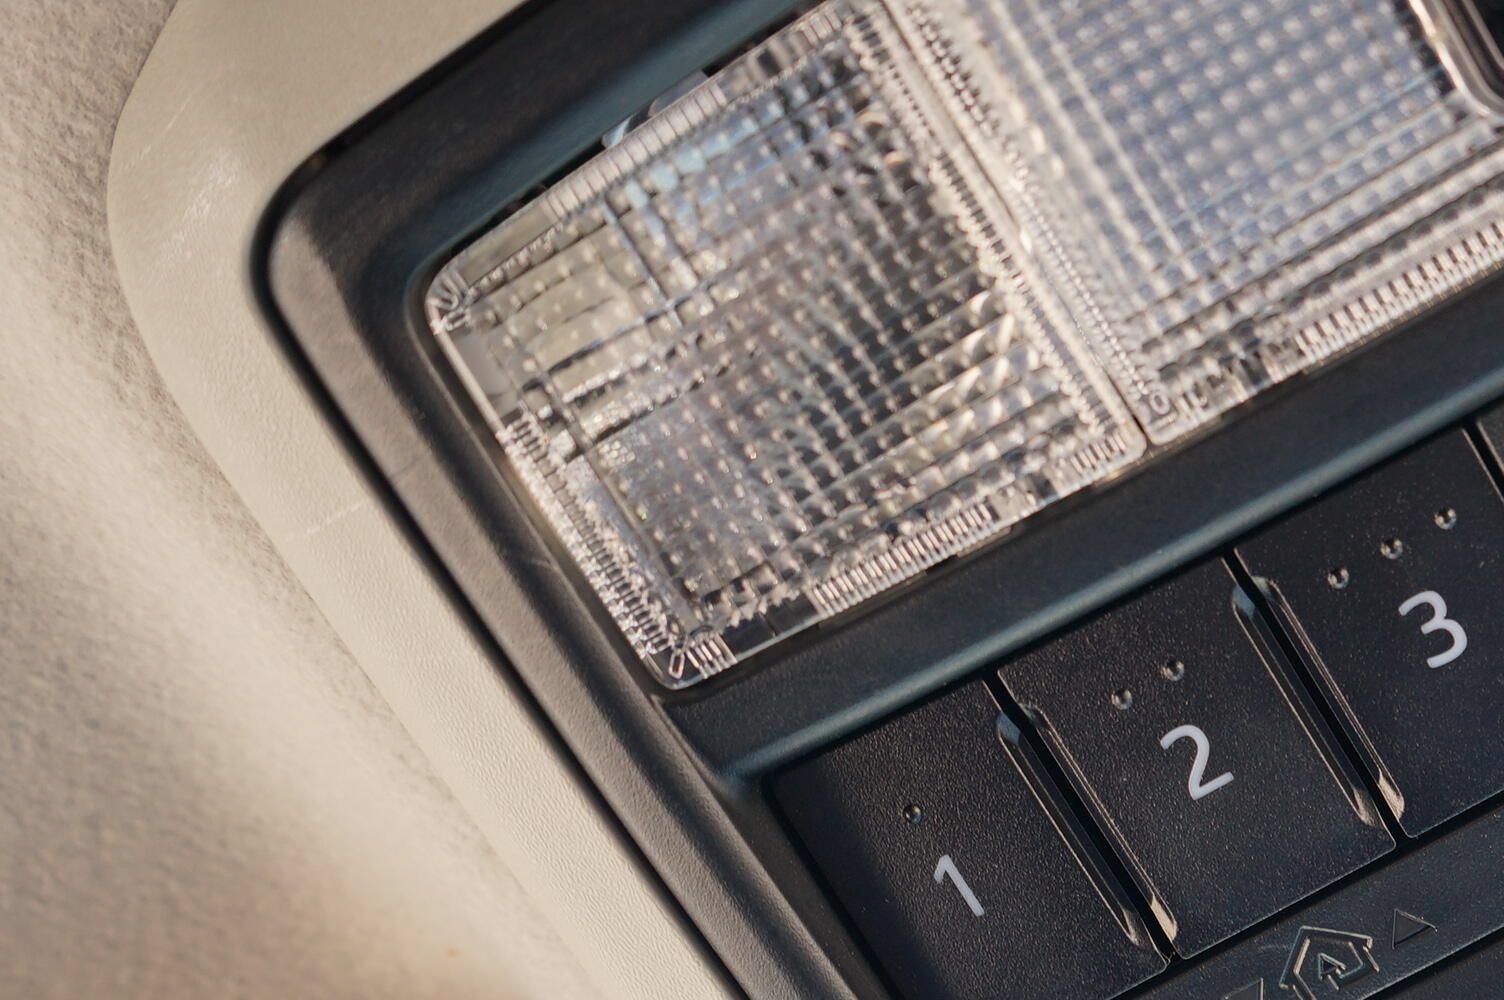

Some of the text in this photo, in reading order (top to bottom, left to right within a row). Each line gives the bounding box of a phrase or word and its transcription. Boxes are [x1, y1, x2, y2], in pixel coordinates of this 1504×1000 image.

[1398, 590, 1468, 669] 3
[1159, 724, 1234, 801] 2
[933, 854, 988, 919] 1
